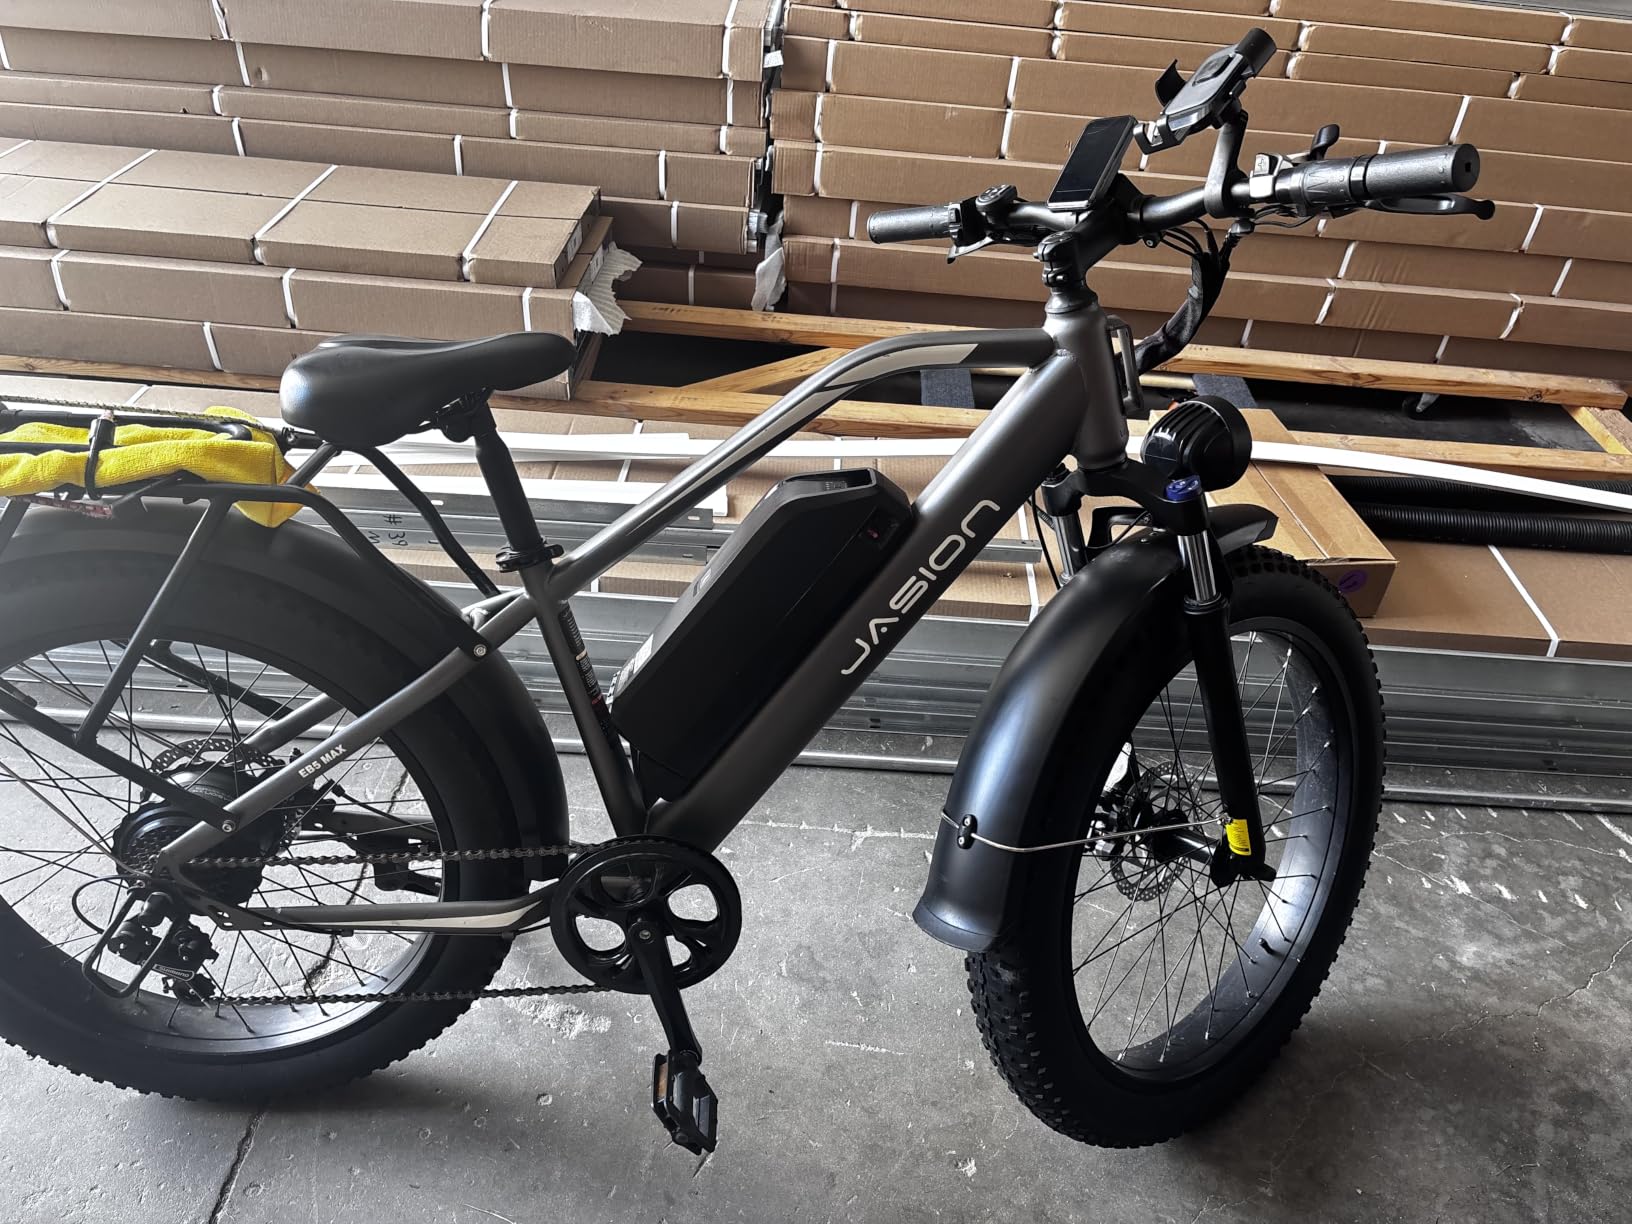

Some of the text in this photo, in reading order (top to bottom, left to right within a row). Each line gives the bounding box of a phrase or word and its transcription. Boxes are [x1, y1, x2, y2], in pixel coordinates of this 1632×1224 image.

[841, 499, 1000, 675] JASION
[298, 744, 347, 778] EB5 MAX
